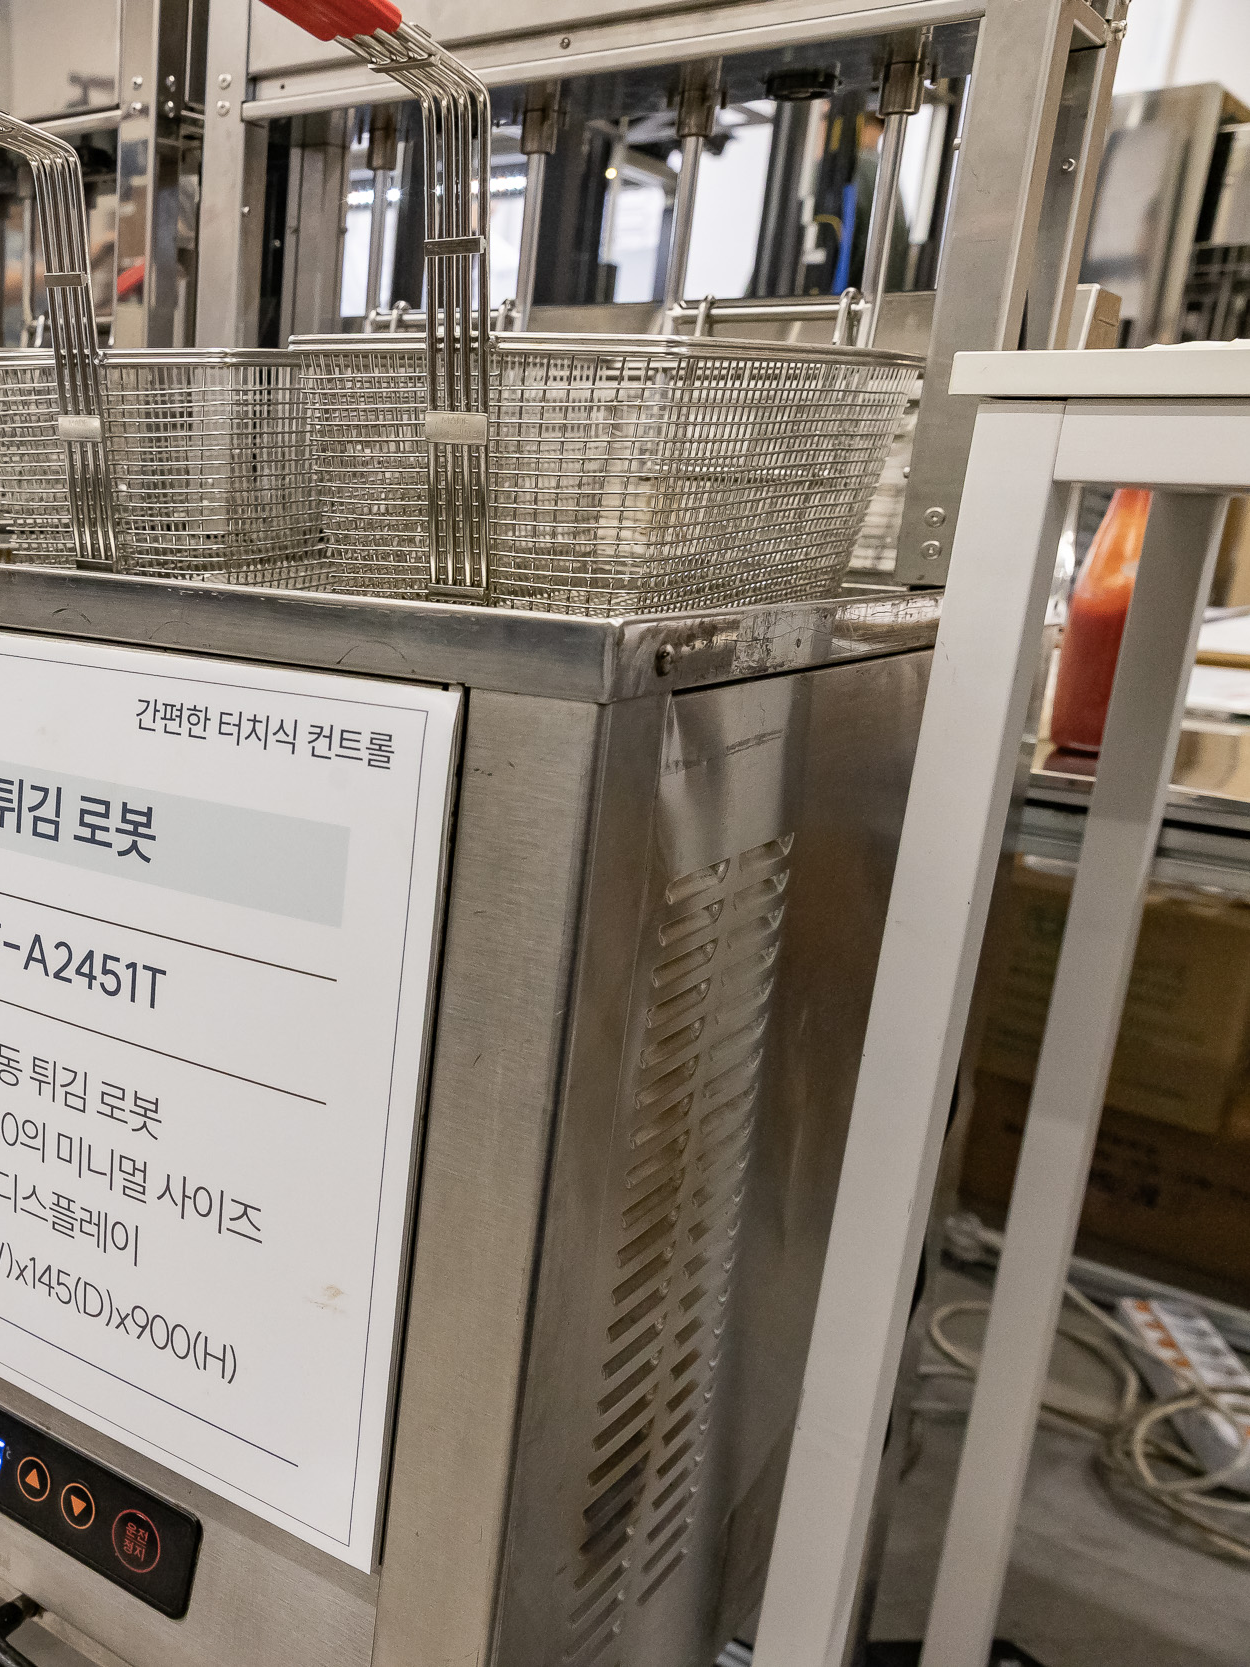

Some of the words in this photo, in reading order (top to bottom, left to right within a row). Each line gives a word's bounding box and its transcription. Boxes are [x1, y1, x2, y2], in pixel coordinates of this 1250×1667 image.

[135, 698, 211, 740] 간편한
[218, 710, 298, 755] 터치식
[307, 722, 395, 770] 컨트롤
[73, 797, 157, 863] 로봇
[29, 1054, 88, 1113] 튀김
[96, 1079, 162, 1140] 로봇
[56, 1127, 148, 1204] 미니멀
[157, 1172, 263, 1243] 사이즈
